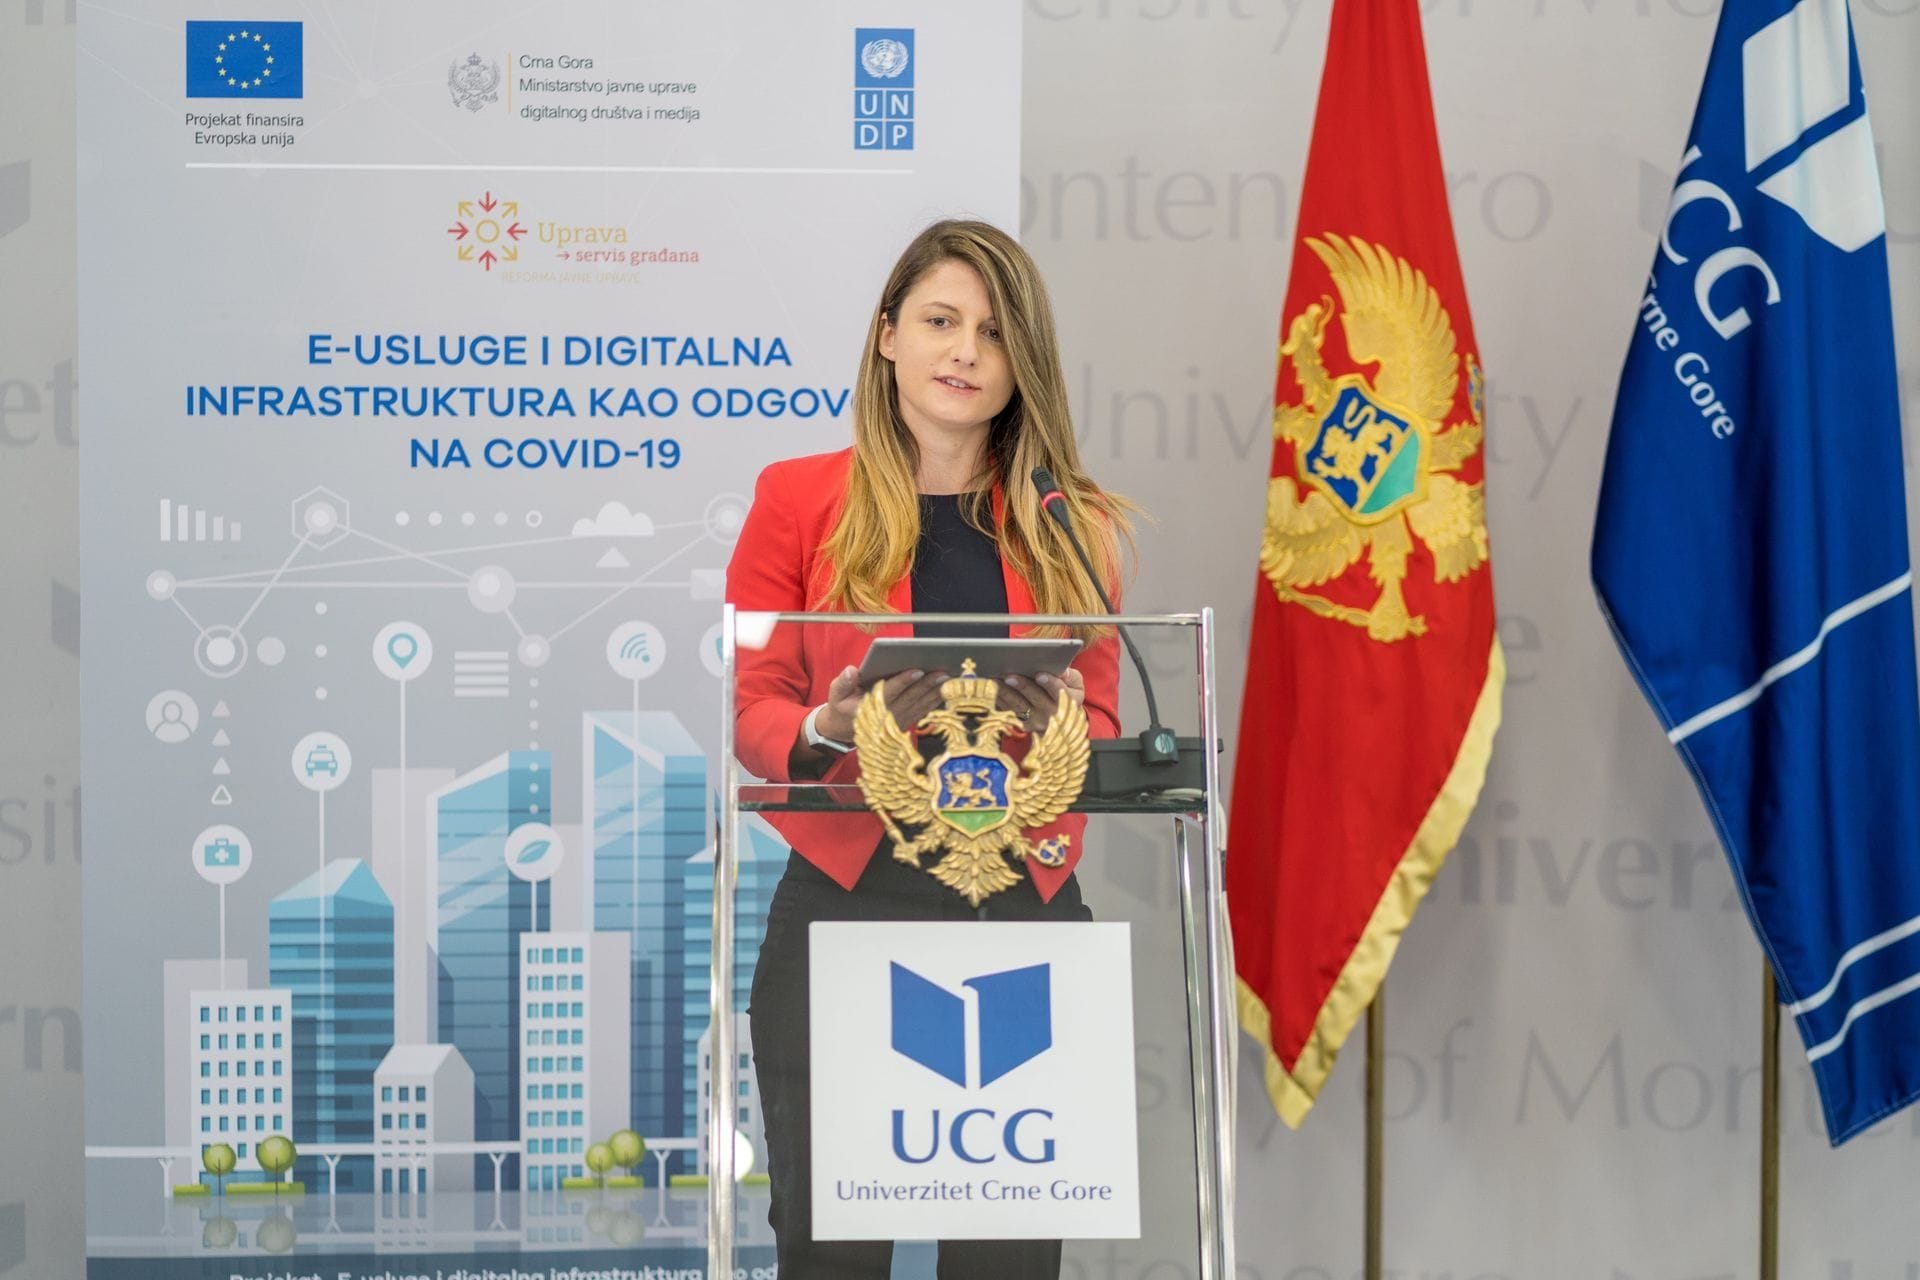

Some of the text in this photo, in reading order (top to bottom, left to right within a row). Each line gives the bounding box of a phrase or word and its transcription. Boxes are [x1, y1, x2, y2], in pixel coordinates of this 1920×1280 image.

[519, 55, 594, 69] Crna Gora
[519, 78, 697, 96] Ministarstvo javne uprave
[185, 112, 304, 129] Projekat finansira
[520, 105, 700, 123] digitalnog društva i medija
[195, 131, 295, 148] Evropska unija
[538, 221, 628, 248] Uprava
[575, 248, 625, 262] servis
[308, 335, 792, 367] E-USLUGE I DIGITALNA
[187, 386, 576, 417] INFRASTRUKTURA
[589, 388, 679, 418] KAO
[1674, 352, 1736, 440] Gore
[410, 438, 681, 468] NA COVID-19
[892, 1108, 1055, 1164] UCG
[836, 1179, 1112, 1201] Univerzitet Crne Gore
